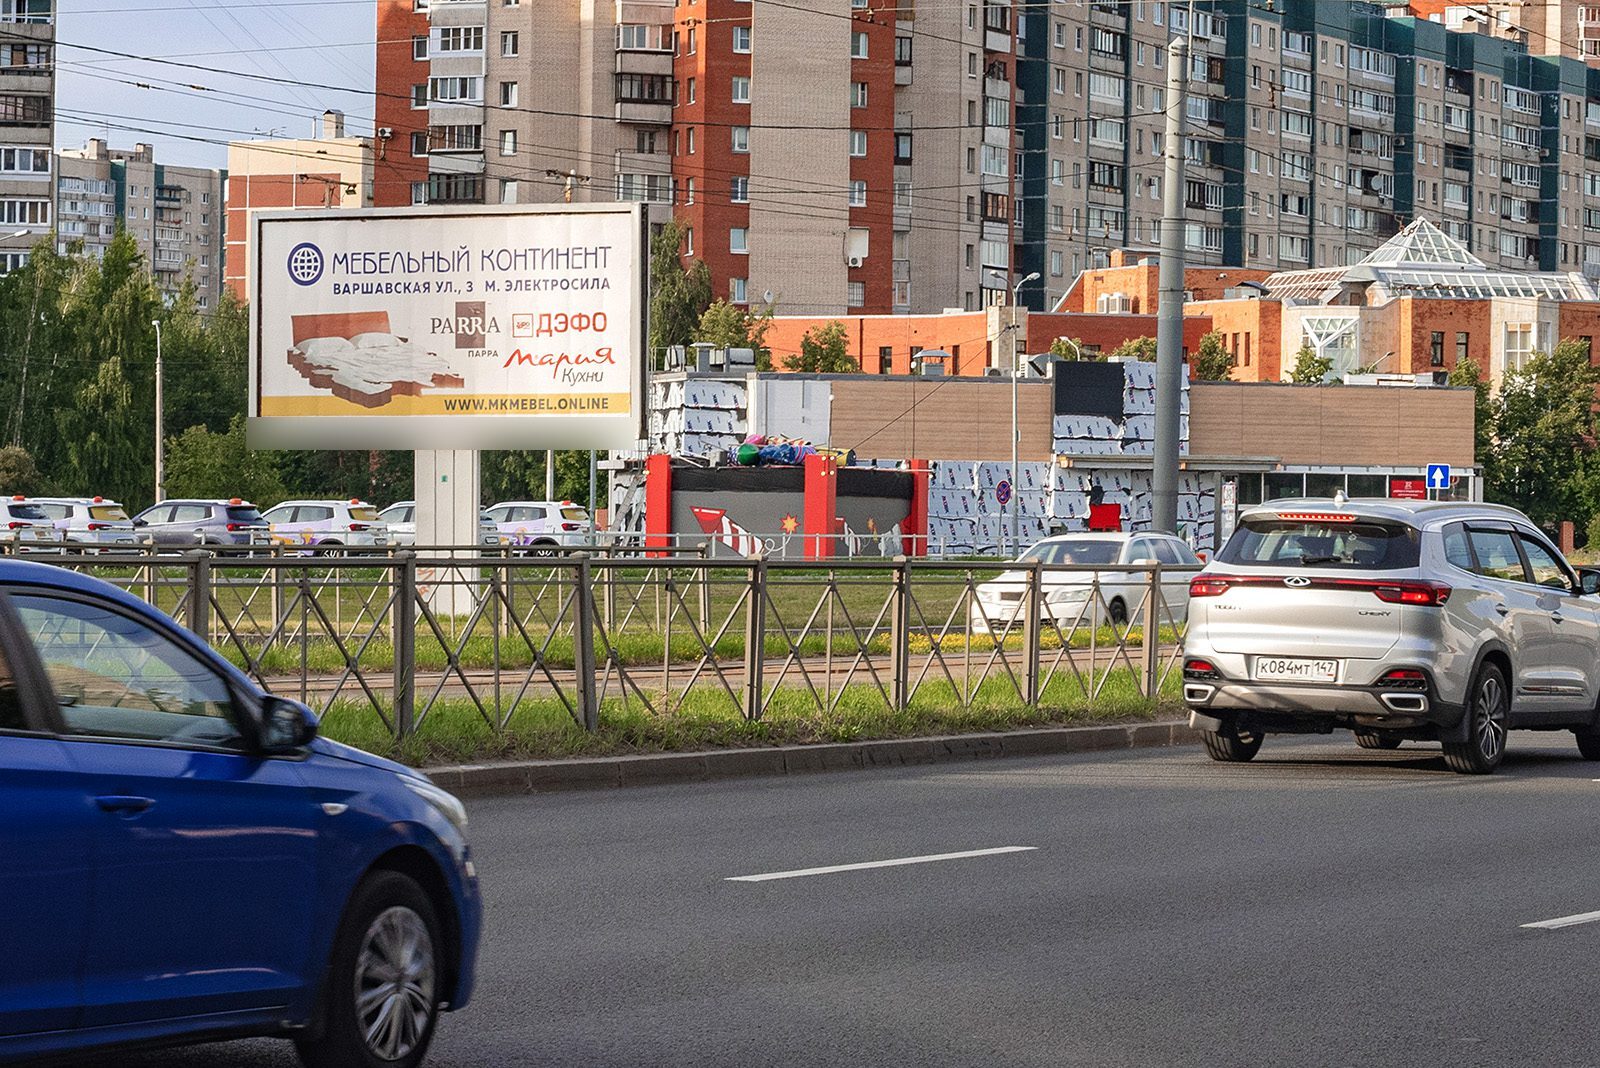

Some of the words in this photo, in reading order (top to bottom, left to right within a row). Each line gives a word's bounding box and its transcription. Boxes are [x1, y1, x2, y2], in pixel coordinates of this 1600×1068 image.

[332, 245, 471, 275] МЕБЕЛЬНЫЙ
[481, 246, 612, 272] КОНТИНЕНТ
[333, 281, 431, 295] ВАРШАВСКАЯ
[436, 281, 462, 295] УЛ.,
[466, 281, 474, 293] 3
[485, 280, 500, 293] М.
[505, 278, 611, 292] ЭЛЕКТРОСИЛА
[430, 316, 501, 336] PARRA
[536, 312, 608, 338] ДЭФО
[468, 350, 499, 358] ПАРРА
[561, 367, 604, 387] Кухни
[444, 397, 609, 411] WWW.MKMEBEL.ONLINE
